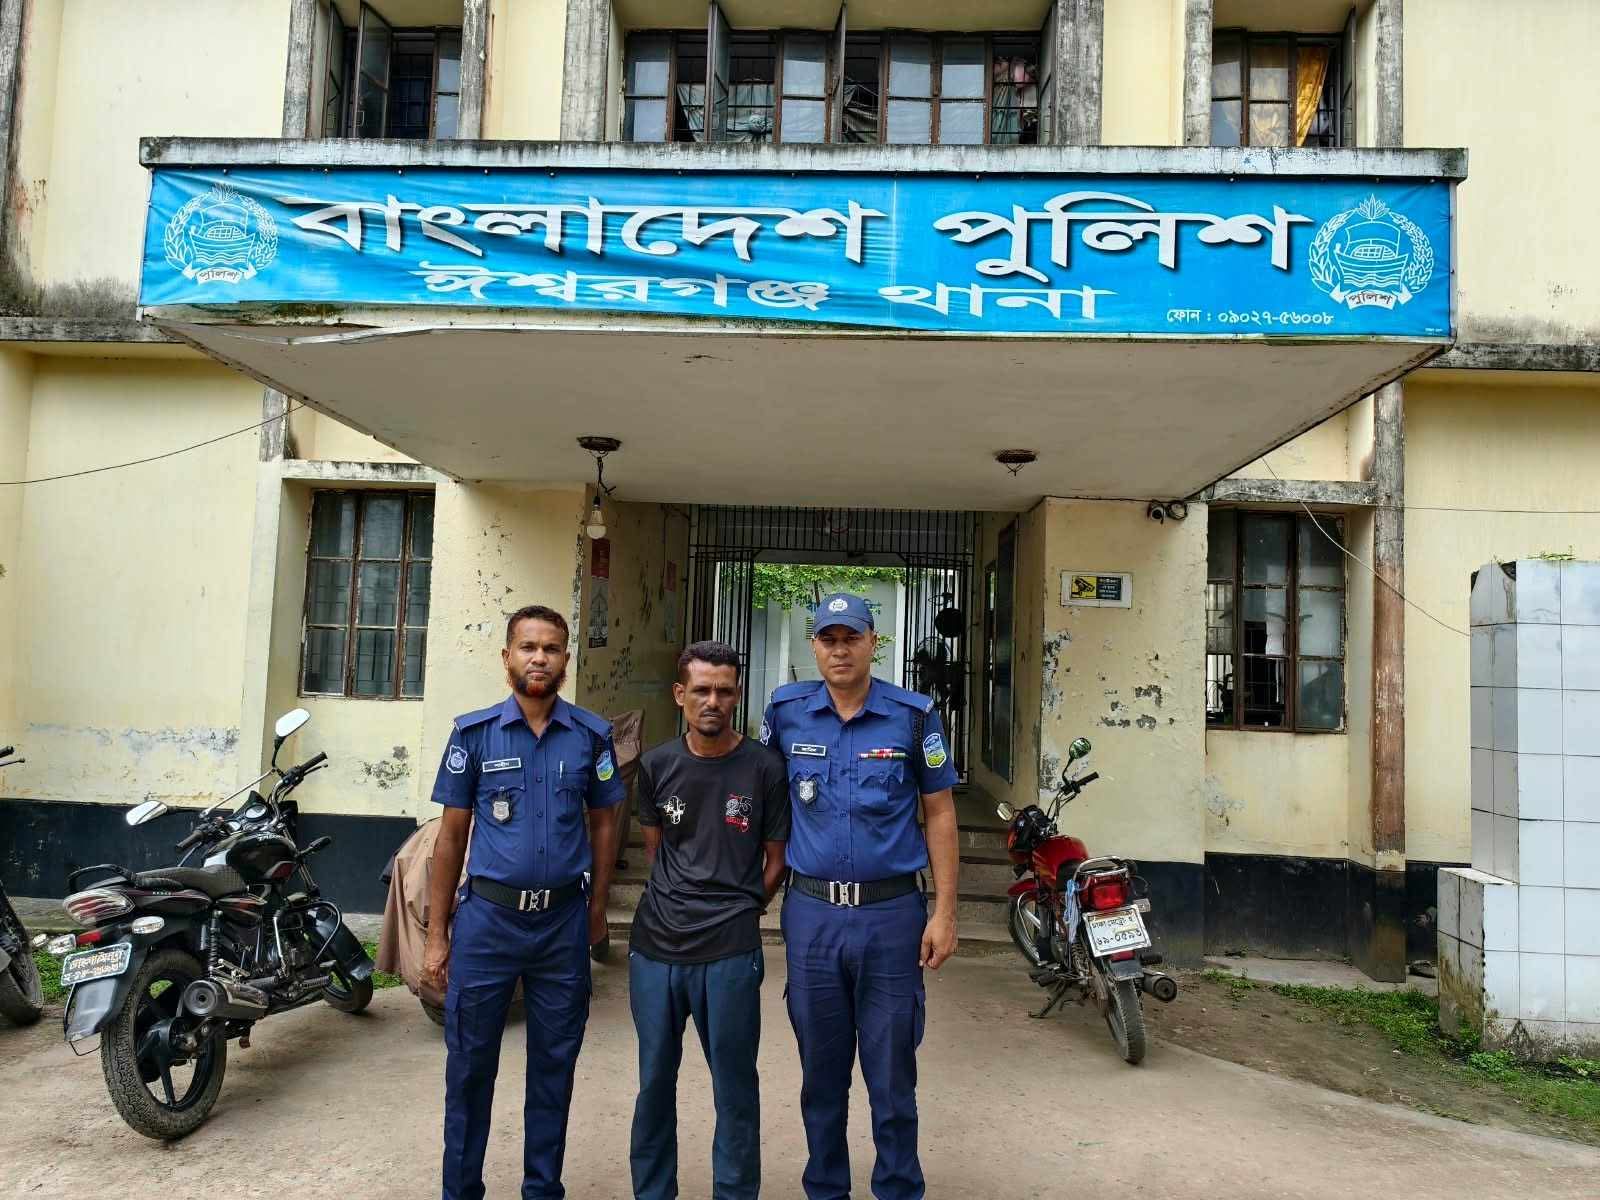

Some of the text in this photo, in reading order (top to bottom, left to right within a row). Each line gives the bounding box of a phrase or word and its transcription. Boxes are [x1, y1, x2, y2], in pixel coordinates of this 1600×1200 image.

[275, 190, 1314, 283] বাংলাদেশ পুলিশ
[408, 260, 1118, 320] ঈশ্বরগঞ্জ থানা
[1348, 291, 1393, 305] পুলিশ
[1166, 308, 1201, 323] ফোন
